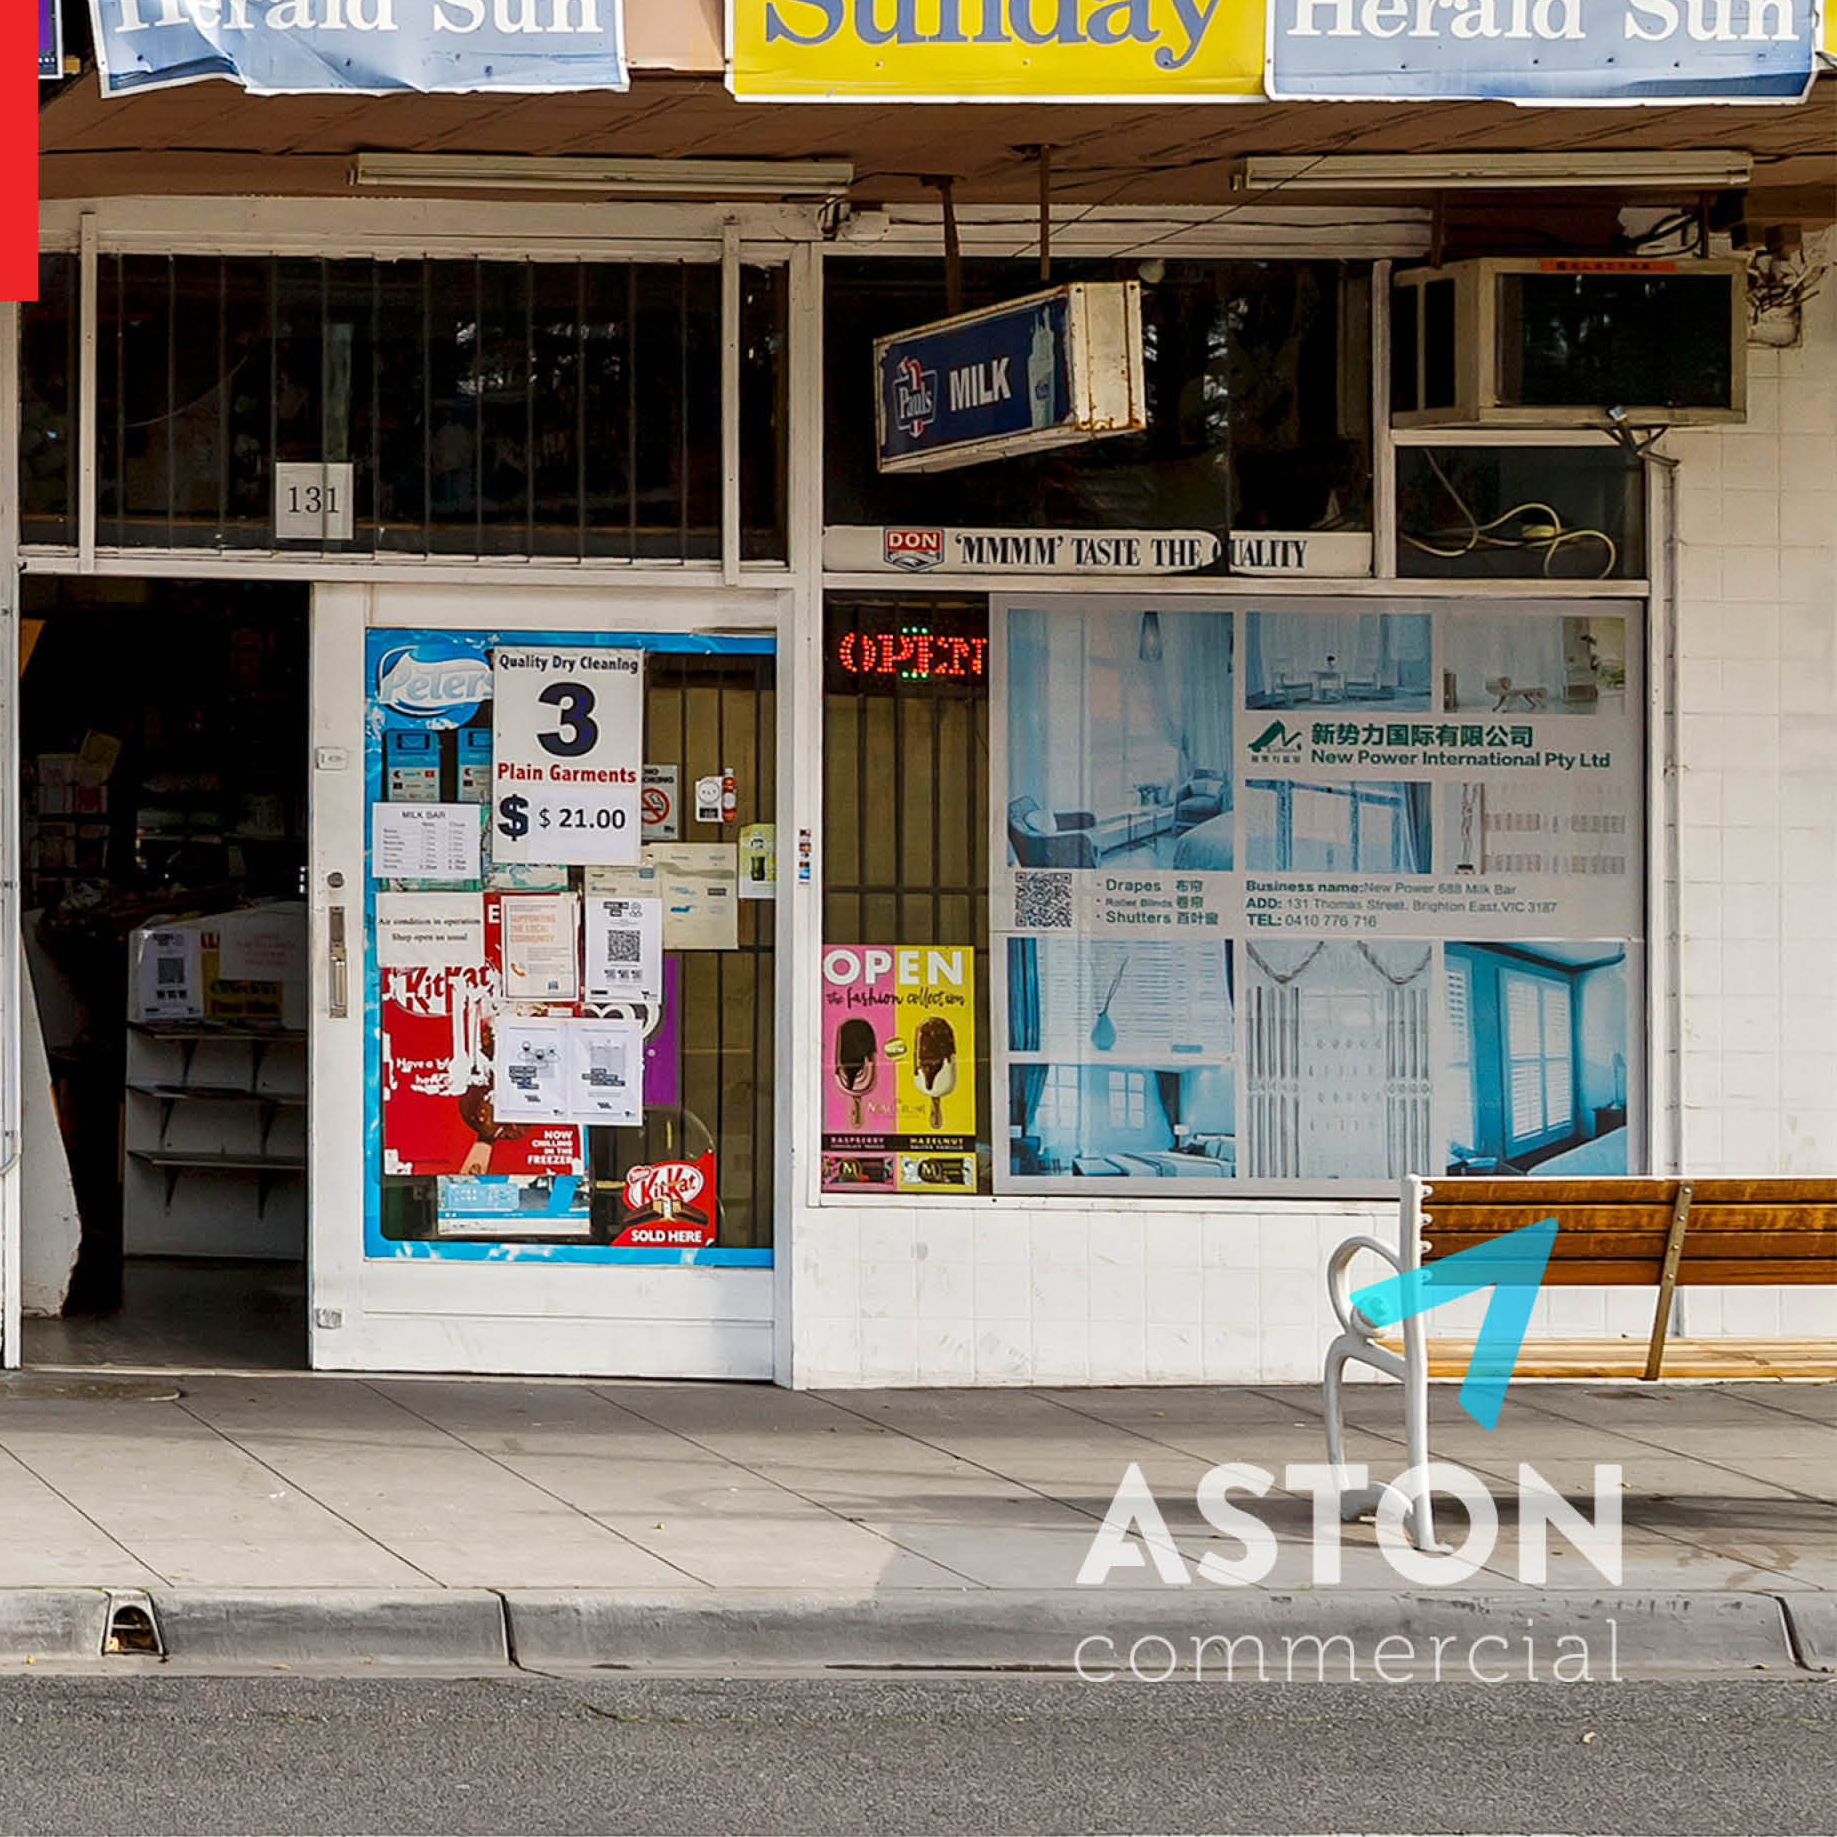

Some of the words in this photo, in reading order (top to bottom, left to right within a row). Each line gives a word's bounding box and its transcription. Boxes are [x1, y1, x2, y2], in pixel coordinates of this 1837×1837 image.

[950, 357, 1012, 411] MILK
[287, 487, 339, 515] 131
[889, 532, 939, 549] DON
[1070, 538, 1141, 565] TASTE
[1151, 539, 1201, 567] THE
[838, 631, 989, 675] OPEN
[499, 654, 548, 673] Quality
[552, 655, 576, 673] Dry
[580, 656, 638, 675] Cleaning
[536, 681, 599, 757] 3
[1311, 723, 1534, 749] 新势力国际有限公司
[1311, 750, 1354, 765] New
[1358, 750, 1419, 766] Power
[1423, 751, 1541, 767] International
[1545, 753, 1576, 770] Pty
[1581, 752, 1611, 768] Ltd
[498, 763, 543, 781] Plain
[550, 764, 637, 784] Garments
[497, 793, 530, 842] $
[539, 807, 551, 829] $
[558, 808, 626, 829] 21.00
[1106, 879, 1162, 893] Drapes
[1246, 881, 1314, 893] Business
[1395, 882, 1435, 894] Power
[1494, 884, 1517, 895] Bar
[1246, 898, 1282, 909] ADD:
[1287, 898, 1311, 909] 131
[1314, 899, 1364, 910] Thomas
[1412, 900, 1466, 914] Brighton
[1527, 902, 1557, 914] 3187
[1106, 911, 1172, 925] Shutters
[1246, 914, 1283, 927] TEL:
[1285, 915, 1320, 927] 0410
[823, 949, 963, 986] OPEN
[846, 987, 902, 1009] fashion
[544, 1130, 573, 1139] NOW
[639, 1167, 696, 1203] KitKat
[631, 1230, 666, 1243] SOLD
[668, 1230, 702, 1243] HERE
